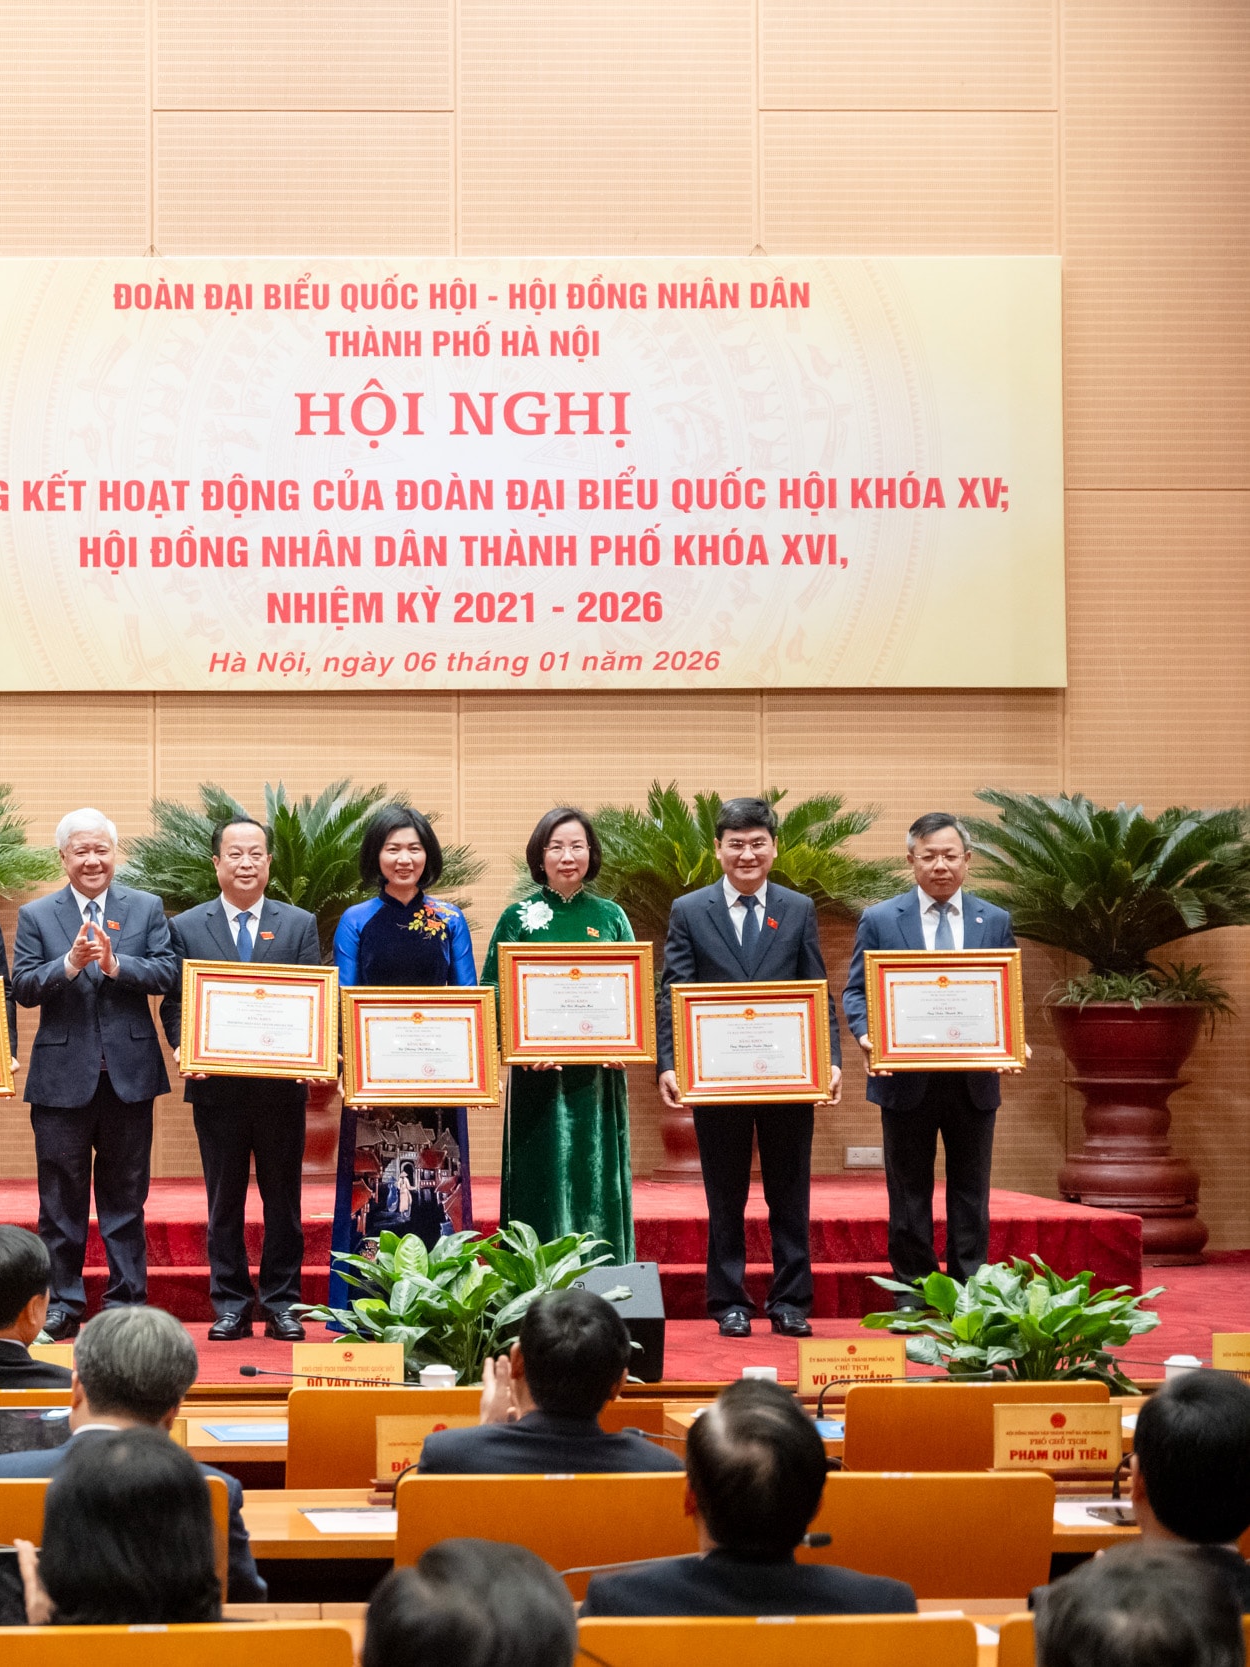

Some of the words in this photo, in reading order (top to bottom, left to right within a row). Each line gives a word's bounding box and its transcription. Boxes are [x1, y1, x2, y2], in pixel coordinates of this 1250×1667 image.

[114, 278, 194, 310] ĐOÀN
[204, 284, 252, 316] ĐẠI
[264, 273, 329, 310] BIỂU
[341, 274, 418, 312] QUỐC
[430, 278, 476, 315] HỘI
[509, 278, 556, 315] HỘI
[567, 274, 647, 309] ĐỒNG
[658, 277, 739, 309] NHÂN
[751, 276, 809, 308] DÂN
[326, 326, 421, 357] THÀNH
[433, 322, 490, 356] PHỐ
[502, 325, 539, 356] HÀ
[550, 325, 599, 362] NỘI
[295, 378, 424, 448] HỘI
[450, 392, 630, 448] NGHỊ
[23, 470, 86, 511] KẾT
[100, 480, 190, 518] HOẠT
[202, 473, 299, 518] ĐỘNG
[313, 469, 384, 511] CỦA
[396, 473, 493, 510] ĐOÀN
[506, 480, 564, 517] ĐẠI
[579, 466, 658, 510] BIỂU
[672, 467, 766, 513] QUỐC
[780, 471, 837, 516] HỘI
[851, 471, 945, 509] KHÓA
[958, 477, 1008, 512] XV;
[80, 530, 137, 575] HỘI
[150, 526, 248, 568] ĐỒNG
[262, 529, 361, 567] NHÂN
[375, 529, 447, 567] DÂN
[460, 529, 577, 566] THÀNH
[591, 524, 660, 566] PHỐ
[674, 528, 769, 566] KHÓA
[782, 534, 848, 568] XVI,
[267, 586, 383, 630] NHIỆM
[397, 585, 440, 623] KỲ
[454, 592, 534, 623] 2021
[577, 591, 662, 623] 2026
[209, 652, 246, 672] Hà
[257, 652, 310, 676] Nội,
[323, 652, 394, 677] ngày
[404, 652, 437, 672] 06
[447, 651, 529, 677] tháng
[540, 652, 569, 672] 01
[582, 652, 642, 671] năm
[653, 650, 720, 671] 2026
[812, 1372, 827, 1385] VŨ
[1010, 1449, 1048, 1463] PHẠM
[1052, 1447, 1074, 1461] QUÍ
[1078, 1447, 1107, 1460] TIÊN
